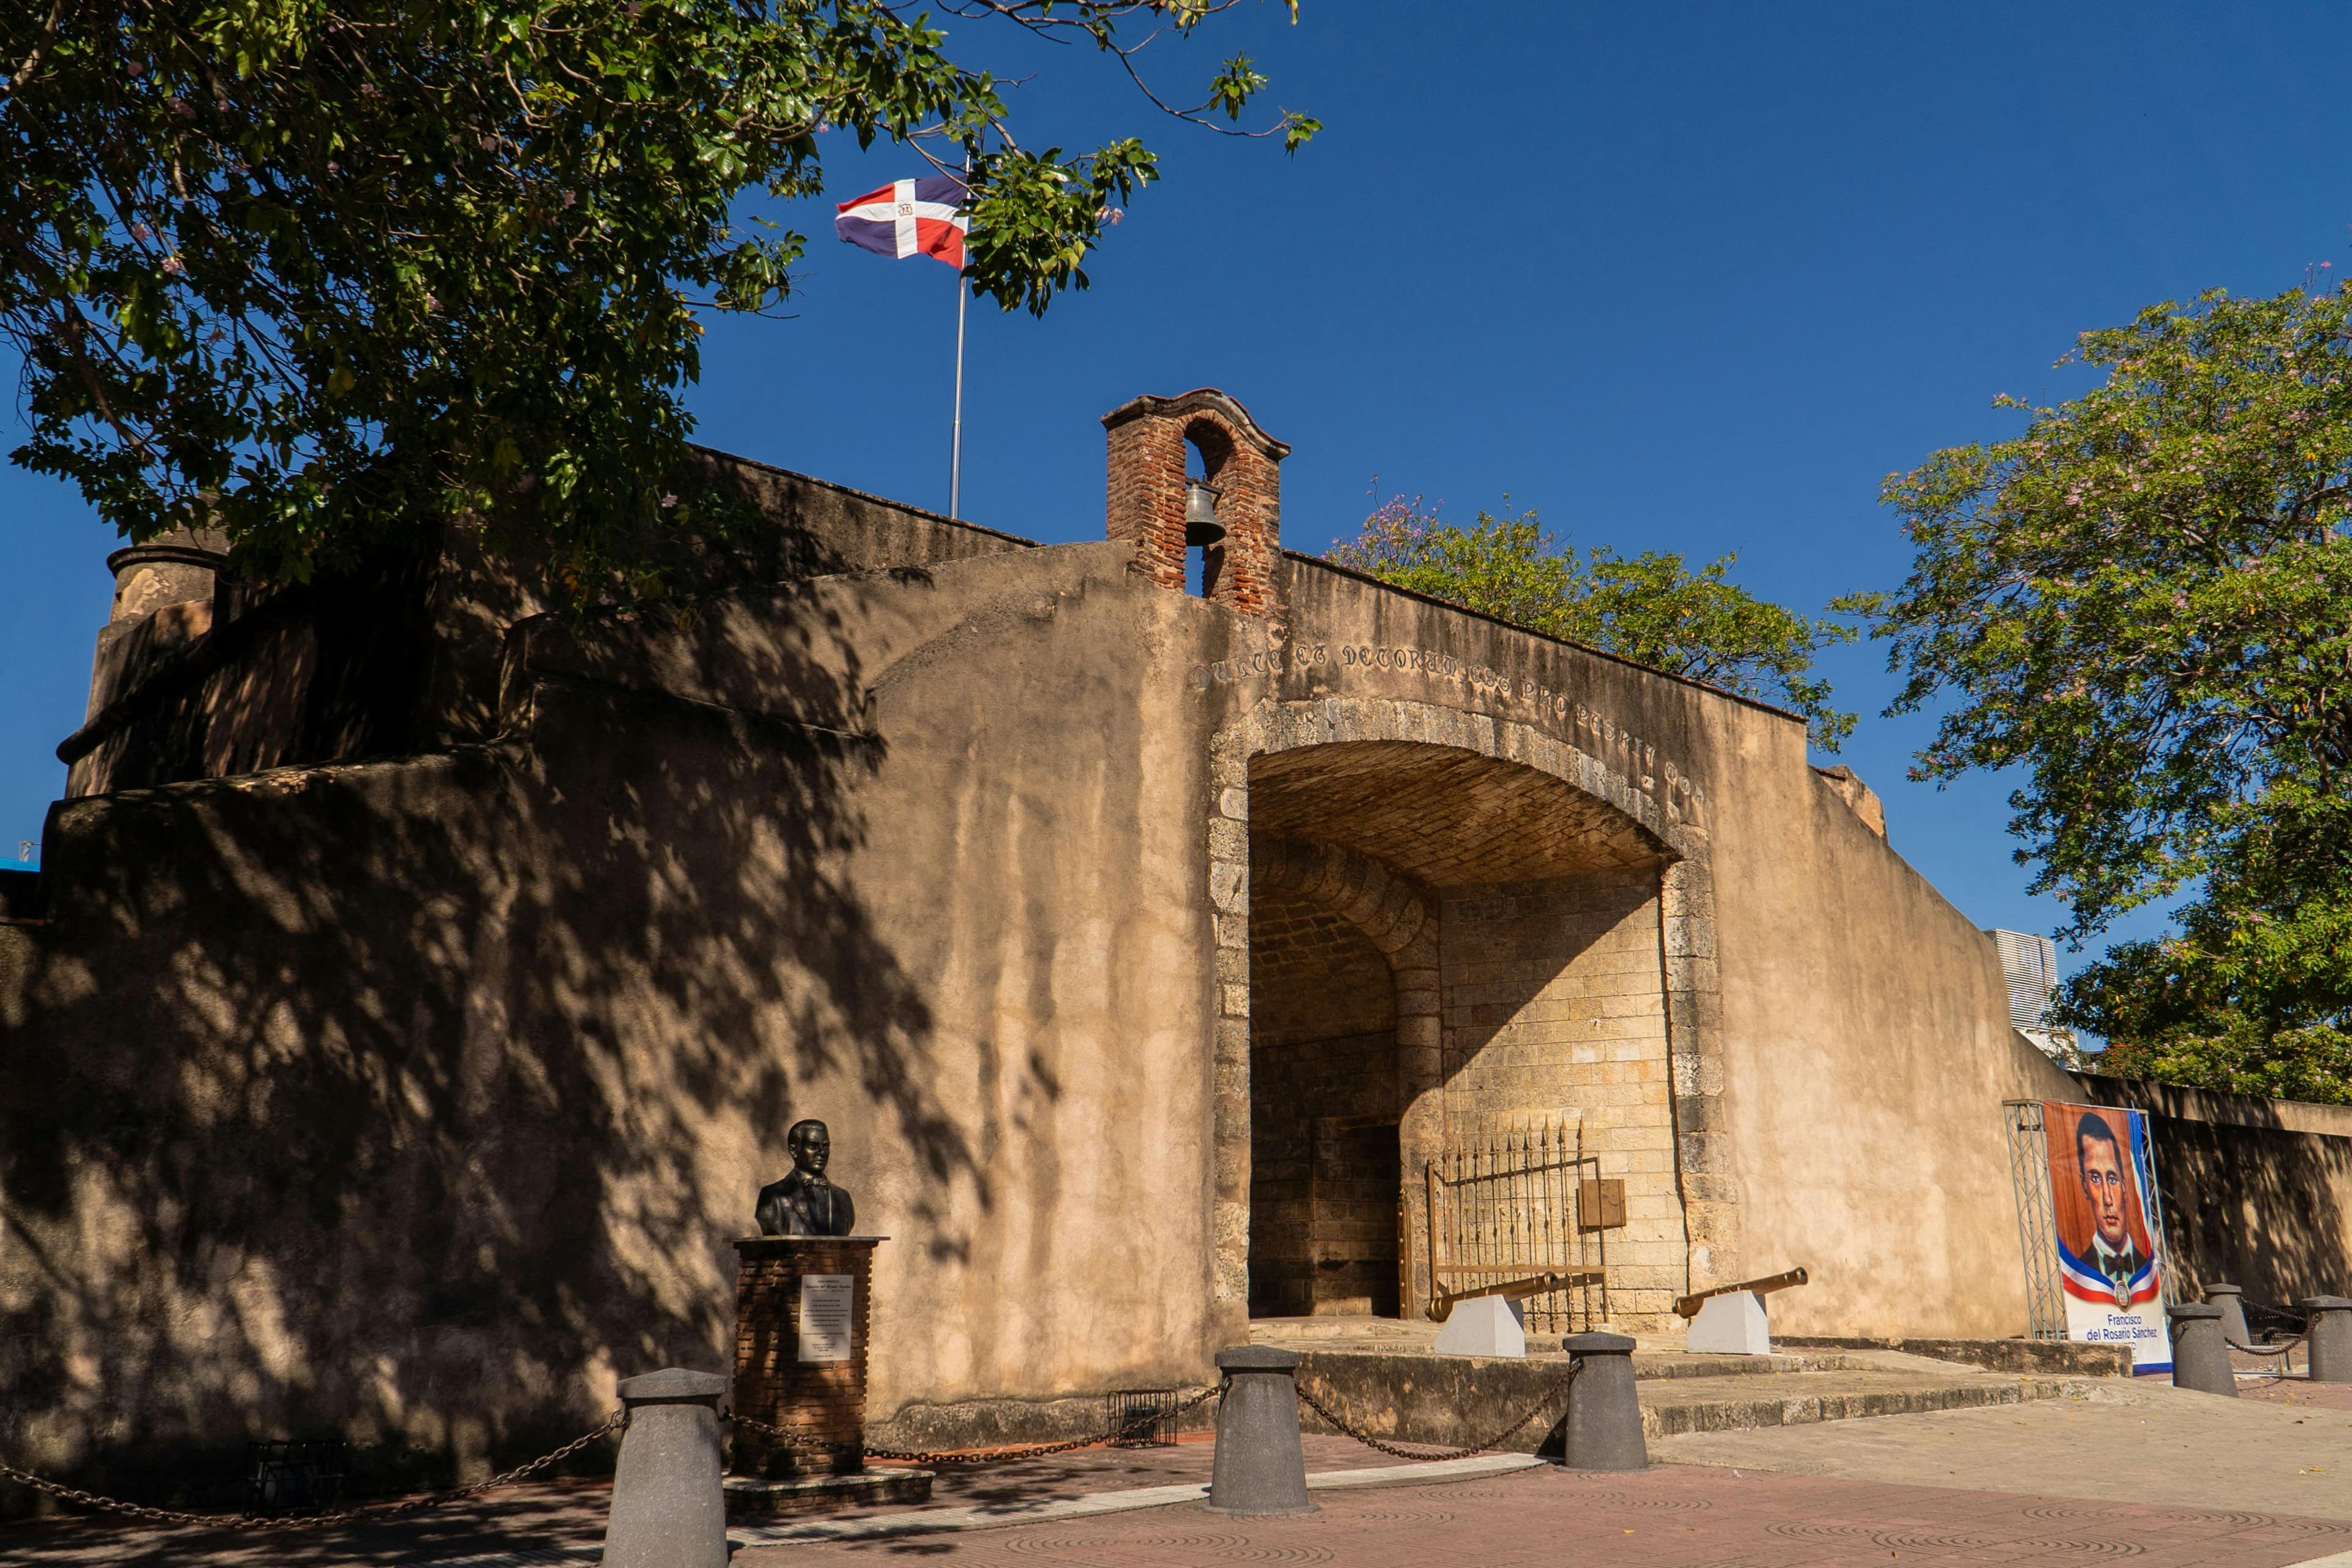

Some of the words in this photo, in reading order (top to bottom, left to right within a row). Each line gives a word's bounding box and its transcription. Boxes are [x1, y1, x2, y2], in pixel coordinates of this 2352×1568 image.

[1295, 645, 1325, 666] ET
[1342, 646, 1457, 676] DECORUM
[1470, 665, 1511, 692] EST
[1522, 680, 1567, 712] PRO
[2108, 1313, 2141, 1325] Francisco
[2087, 1329, 2101, 1341] del
[2103, 1327, 2130, 1340] Rosario
[2132, 1326, 2157, 1338] Sánchez
